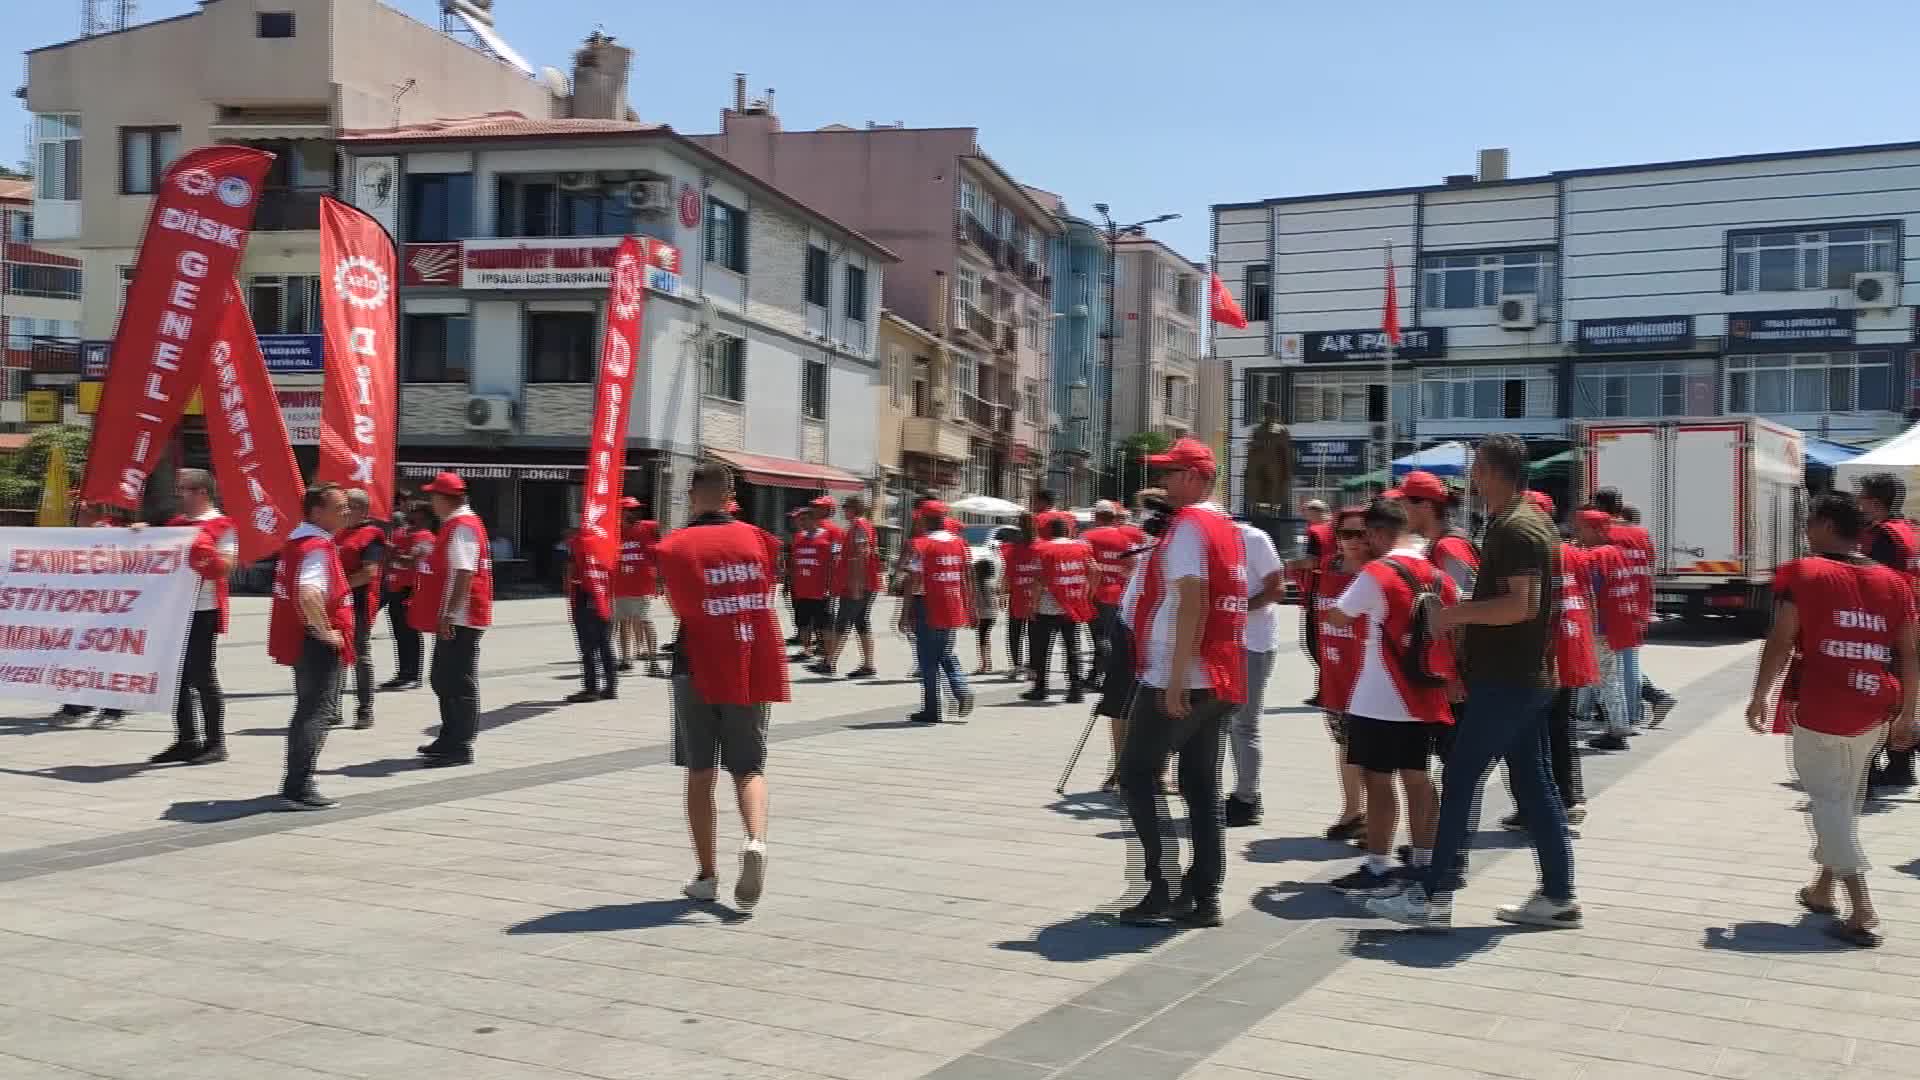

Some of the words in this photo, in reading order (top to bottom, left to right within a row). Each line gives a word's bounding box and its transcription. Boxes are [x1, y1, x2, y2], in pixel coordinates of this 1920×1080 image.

[1321, 335, 1354, 352] AK
[0, 584, 142, 615] STİYORUZ
[77, 627, 147, 656] SON
